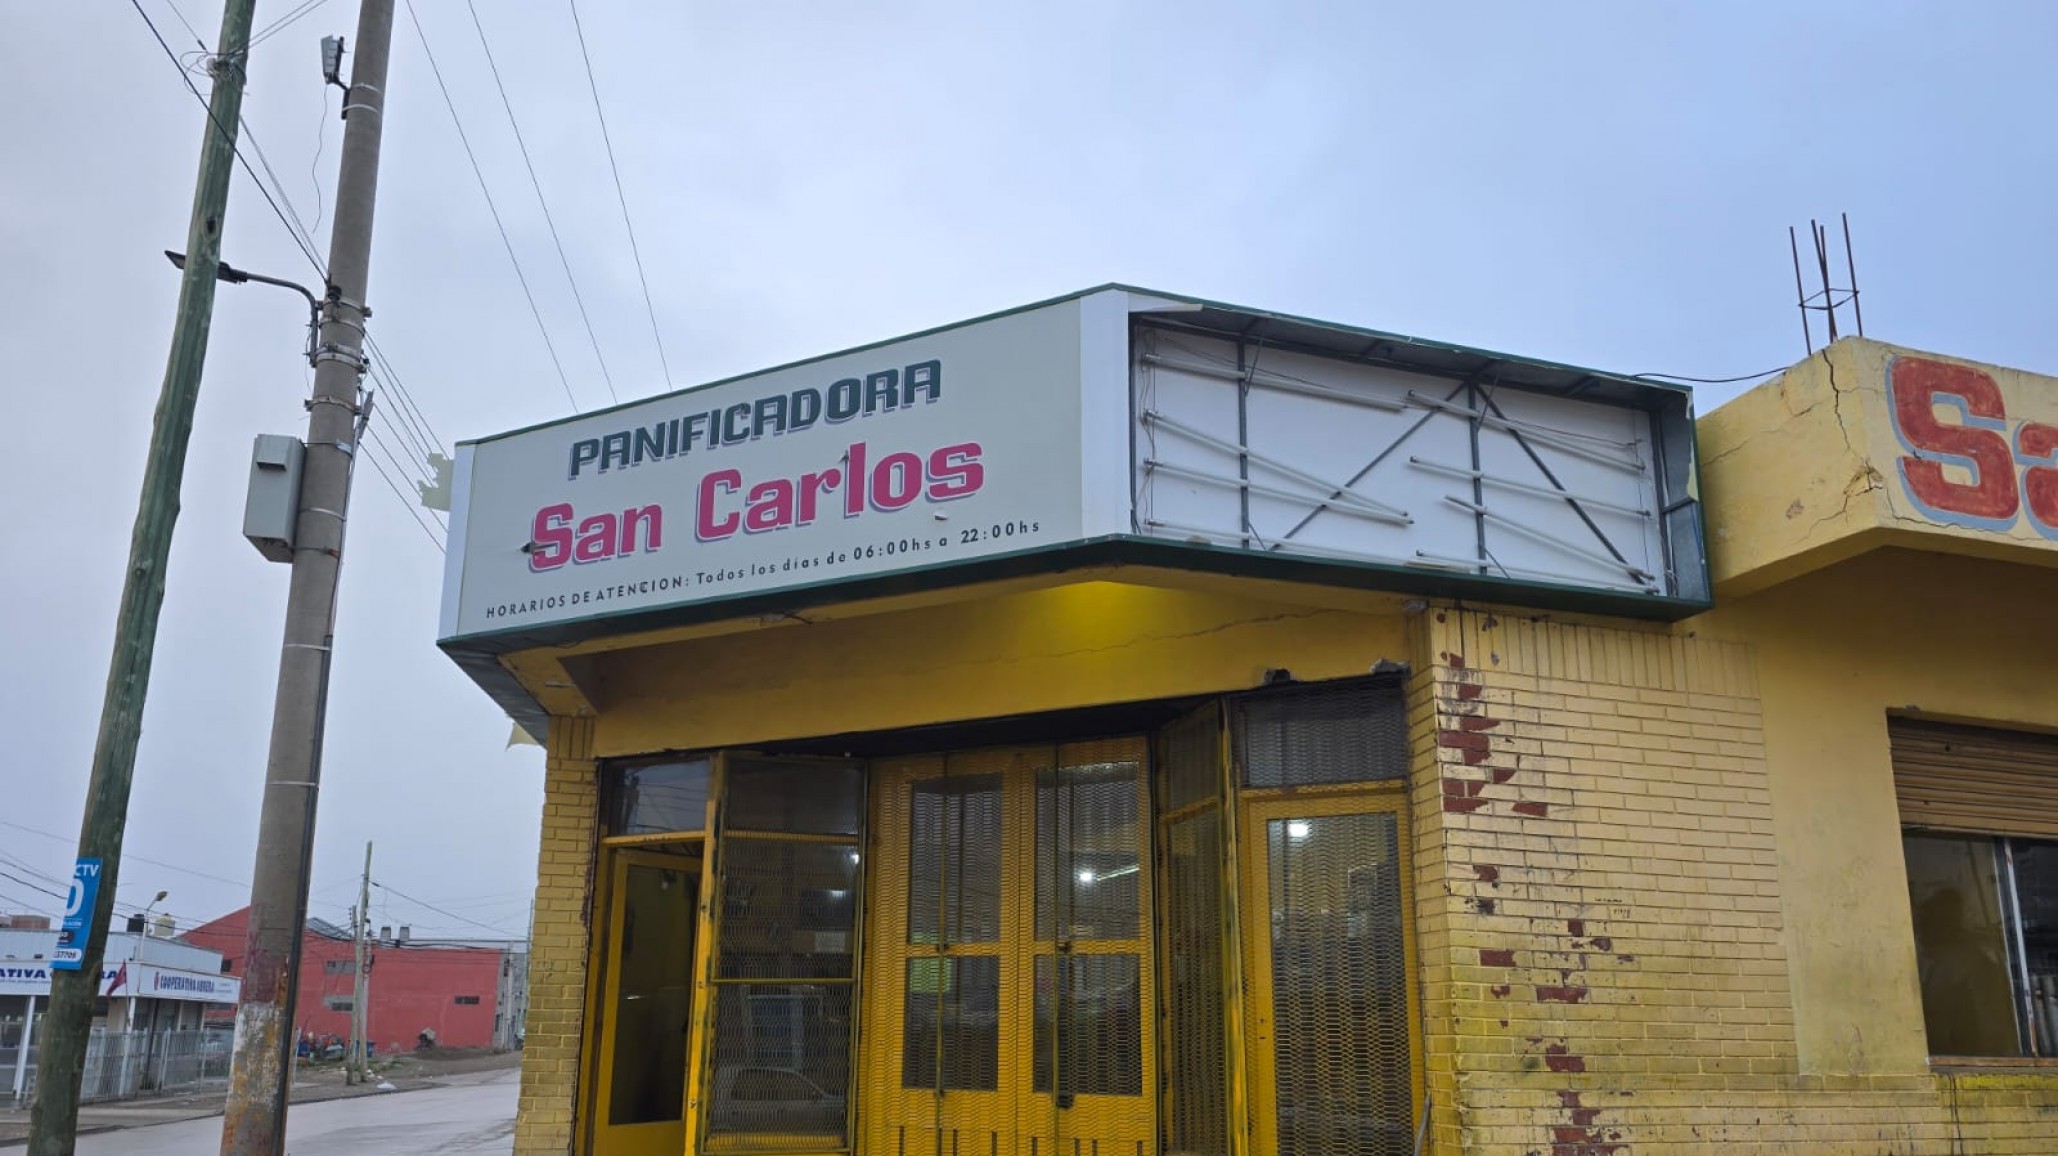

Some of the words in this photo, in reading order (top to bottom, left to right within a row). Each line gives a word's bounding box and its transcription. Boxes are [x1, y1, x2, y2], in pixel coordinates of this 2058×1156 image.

[568, 359, 942, 480] PANIFICADORA
[528, 502, 663, 572] San
[695, 442, 985, 541] Carlos
[486, 595, 566, 618] HORARIOS
[571, 591, 590, 605] DE
[595, 577, 690, 601] ATENCION:
[696, 566, 744, 585] Todos
[751, 563, 775, 577] los
[826, 552, 845, 565] de
[939, 536, 948, 547] a
